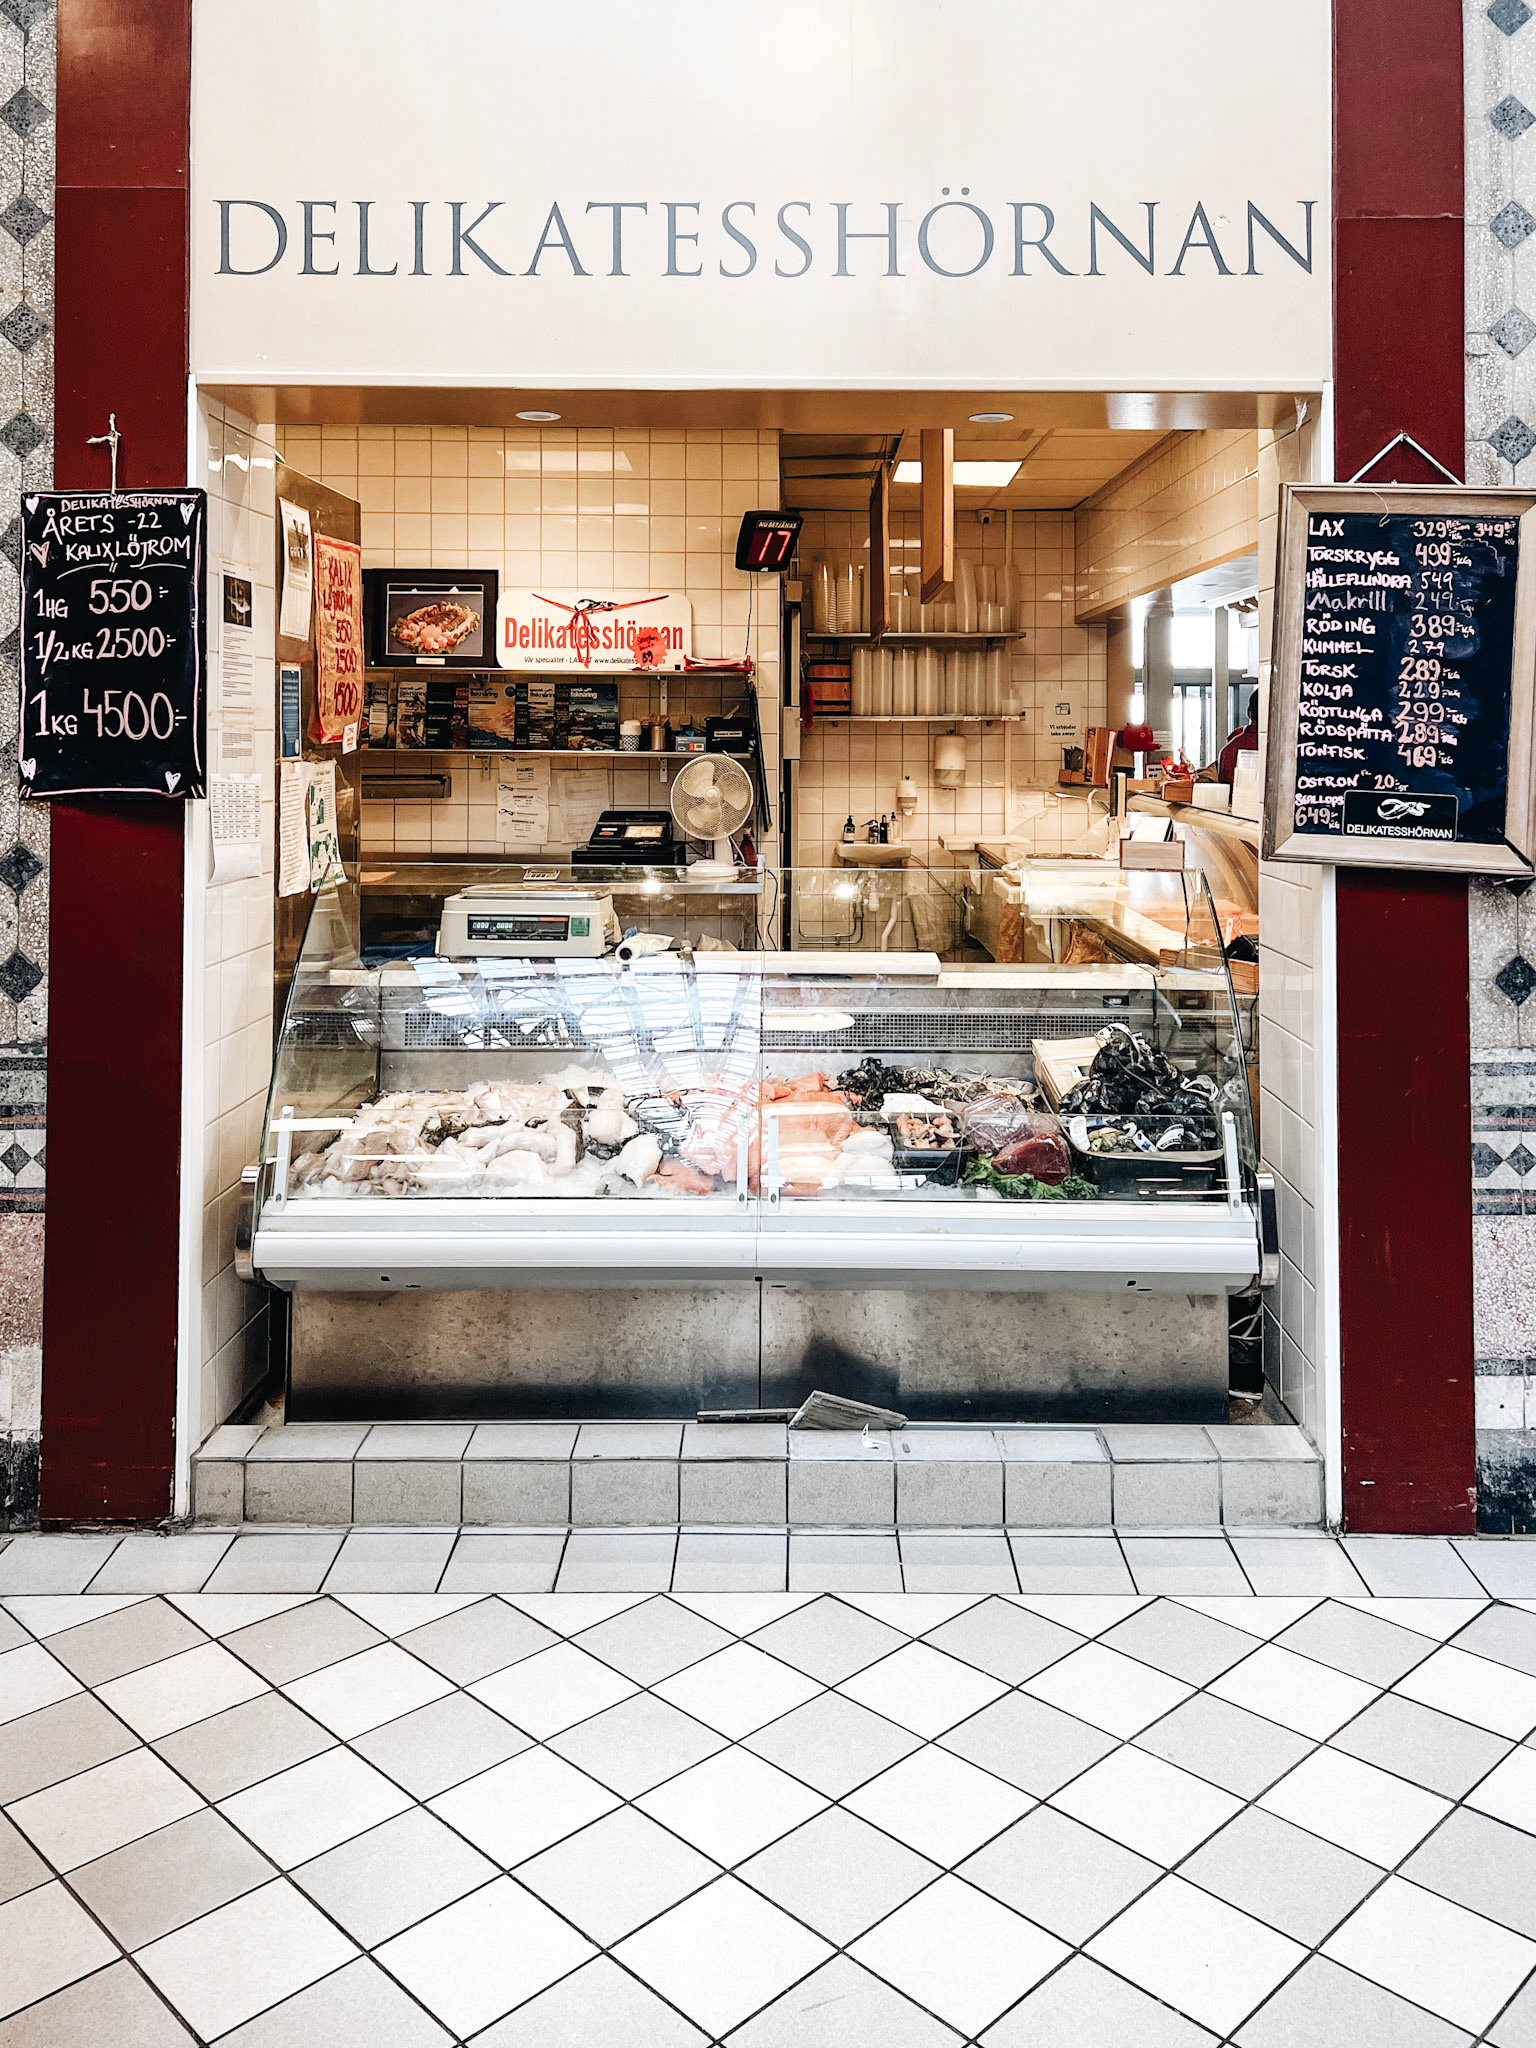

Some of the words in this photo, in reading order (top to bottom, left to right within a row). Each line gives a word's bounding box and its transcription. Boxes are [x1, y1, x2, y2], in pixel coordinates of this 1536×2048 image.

[213, 187, 1318, 278] DELIKATESSHÖRNAN
[42, 508, 115, 545] ÅRETS
[1309, 517, 1345, 537] LAX
[758, 531, 792, 562] 17
[1307, 546, 1400, 571] TORSKRYGG
[1420, 571, 1453, 591] 549
[1306, 590, 1386, 611] Makrill
[1306, 613, 1376, 635] RÖDING
[1303, 638, 1374, 654] KUMMEL
[1408, 639, 1445, 657] 279
[1301, 659, 1358, 678] TORSK
[1302, 681, 1353, 700] KOLJA
[1299, 699, 1383, 722] RÖDTUNGA
[1299, 719, 1393, 742] RÖDSPÄTTA
[1297, 742, 1365, 760] TONFISK
[1347, 823, 1452, 839] DELIKATESSHÖRNAN
